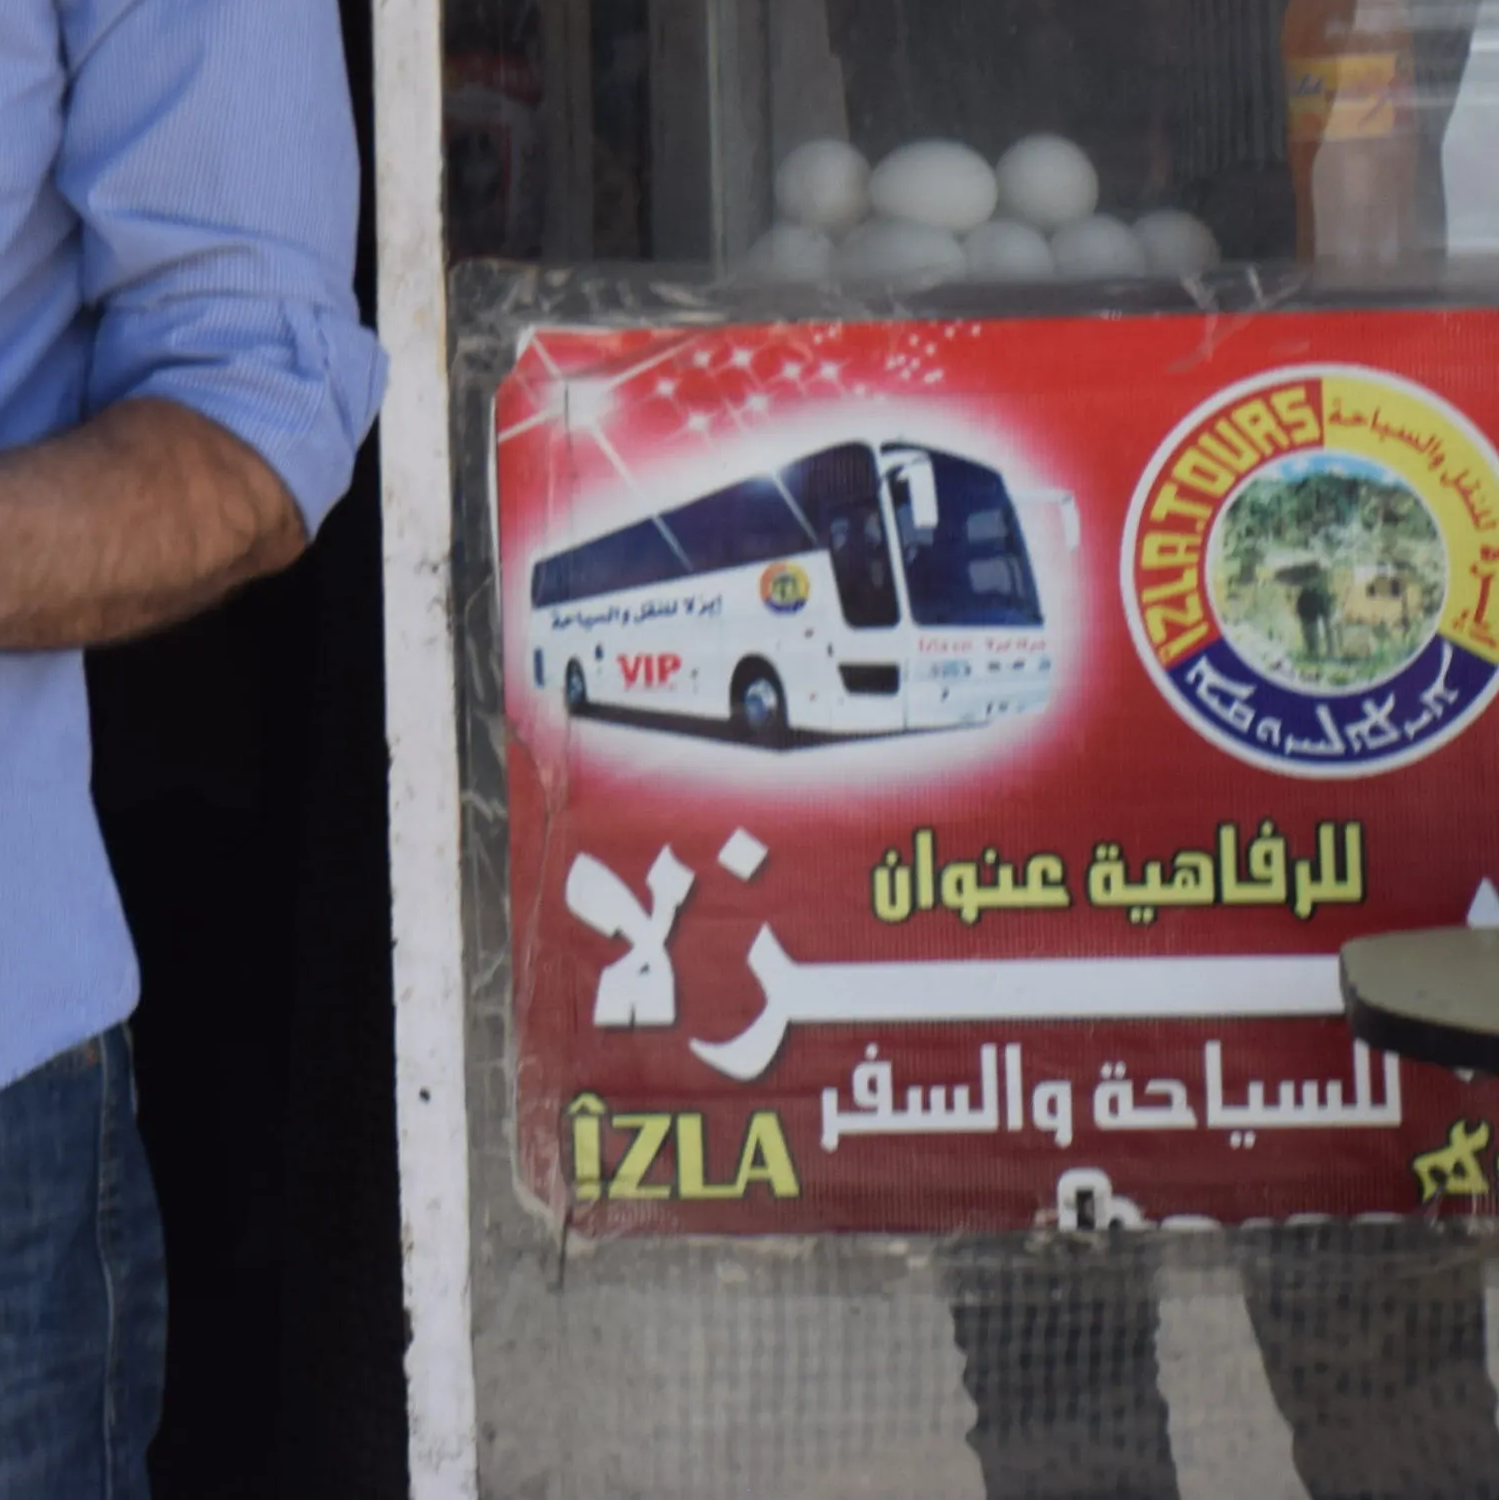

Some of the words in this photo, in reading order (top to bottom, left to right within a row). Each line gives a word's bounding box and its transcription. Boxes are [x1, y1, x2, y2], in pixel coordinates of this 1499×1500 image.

[617, 653, 683, 689] VIP
[874, 828, 1071, 925] عنوان
[1088, 820, 1364, 925] للرفاهية
[821, 1043, 1073, 1153] والسفر
[1094, 1038, 1402, 1150] للسياحة
